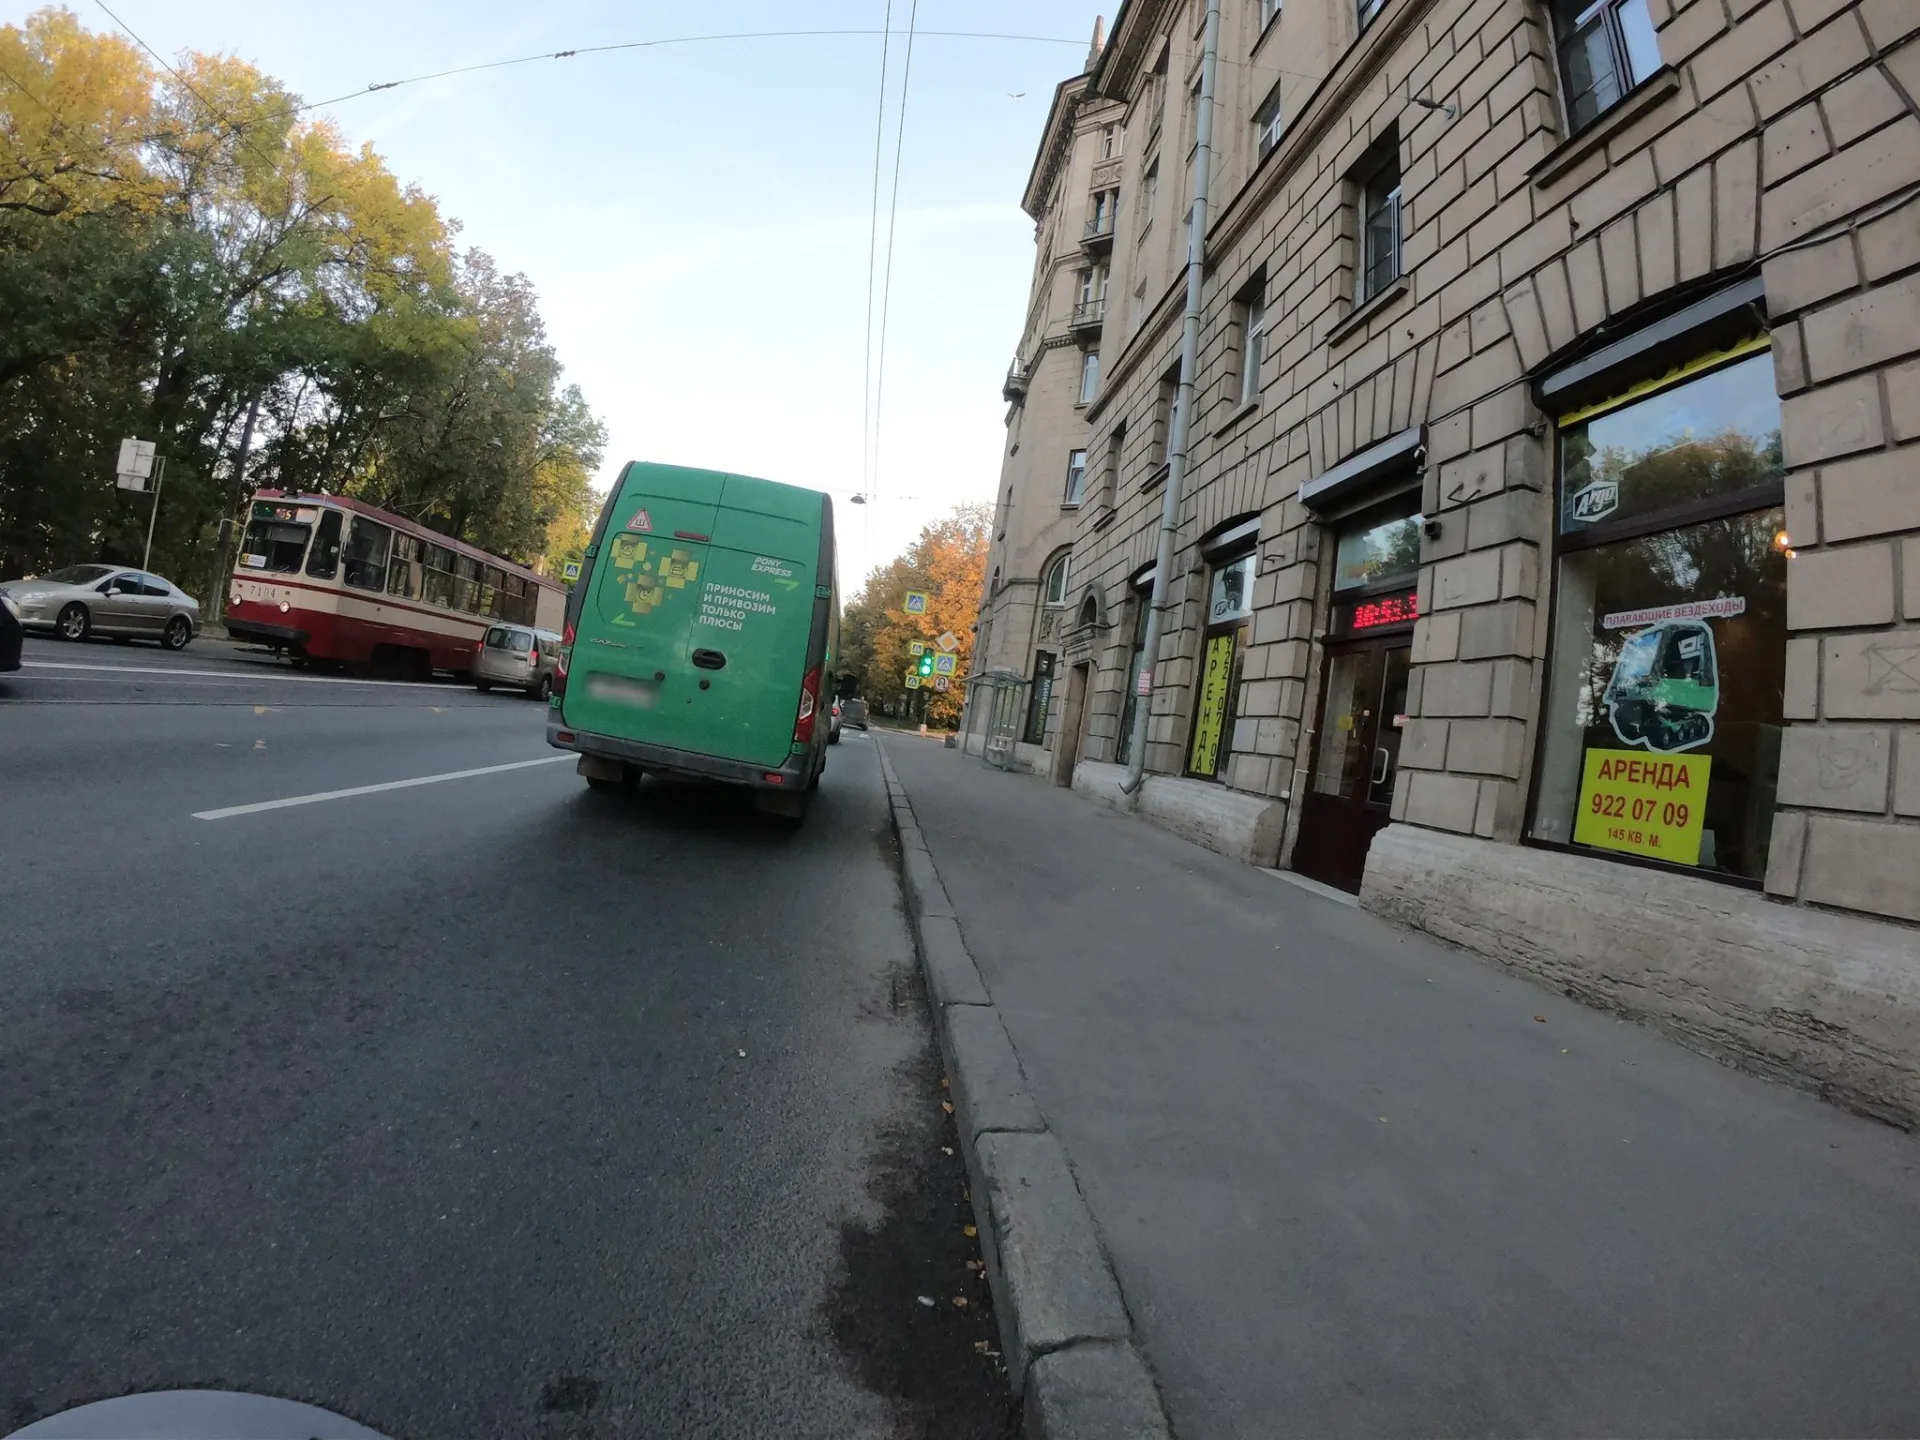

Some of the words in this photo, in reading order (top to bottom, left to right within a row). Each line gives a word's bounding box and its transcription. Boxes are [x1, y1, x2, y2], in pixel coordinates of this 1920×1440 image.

[751, 563, 792, 577] EXPRESS
[755, 557, 782, 567] PONY
[250, 585, 276, 599] 7104
[706, 582, 770, 602] ПРИНОСИМ
[702, 604, 745, 620] ТОЛЬКО
[703, 593, 712, 602] И
[714, 595, 776, 614] ПРИВОЗИМ
[1675, 600, 1743, 618] ВЕЗДЕХОДЫ
[699, 615, 742, 630] ПЛЮСЫ
[1195, 638, 1219, 773] АРЕНДА
[1597, 758, 1690, 791] АРЕНДА
[1591, 793, 1626, 818] 922
[1632, 798, 1657, 821] 07
[1663, 802, 1688, 827] 09
[1608, 827, 1625, 840] 145
[1628, 830, 1644, 844] КВ.
